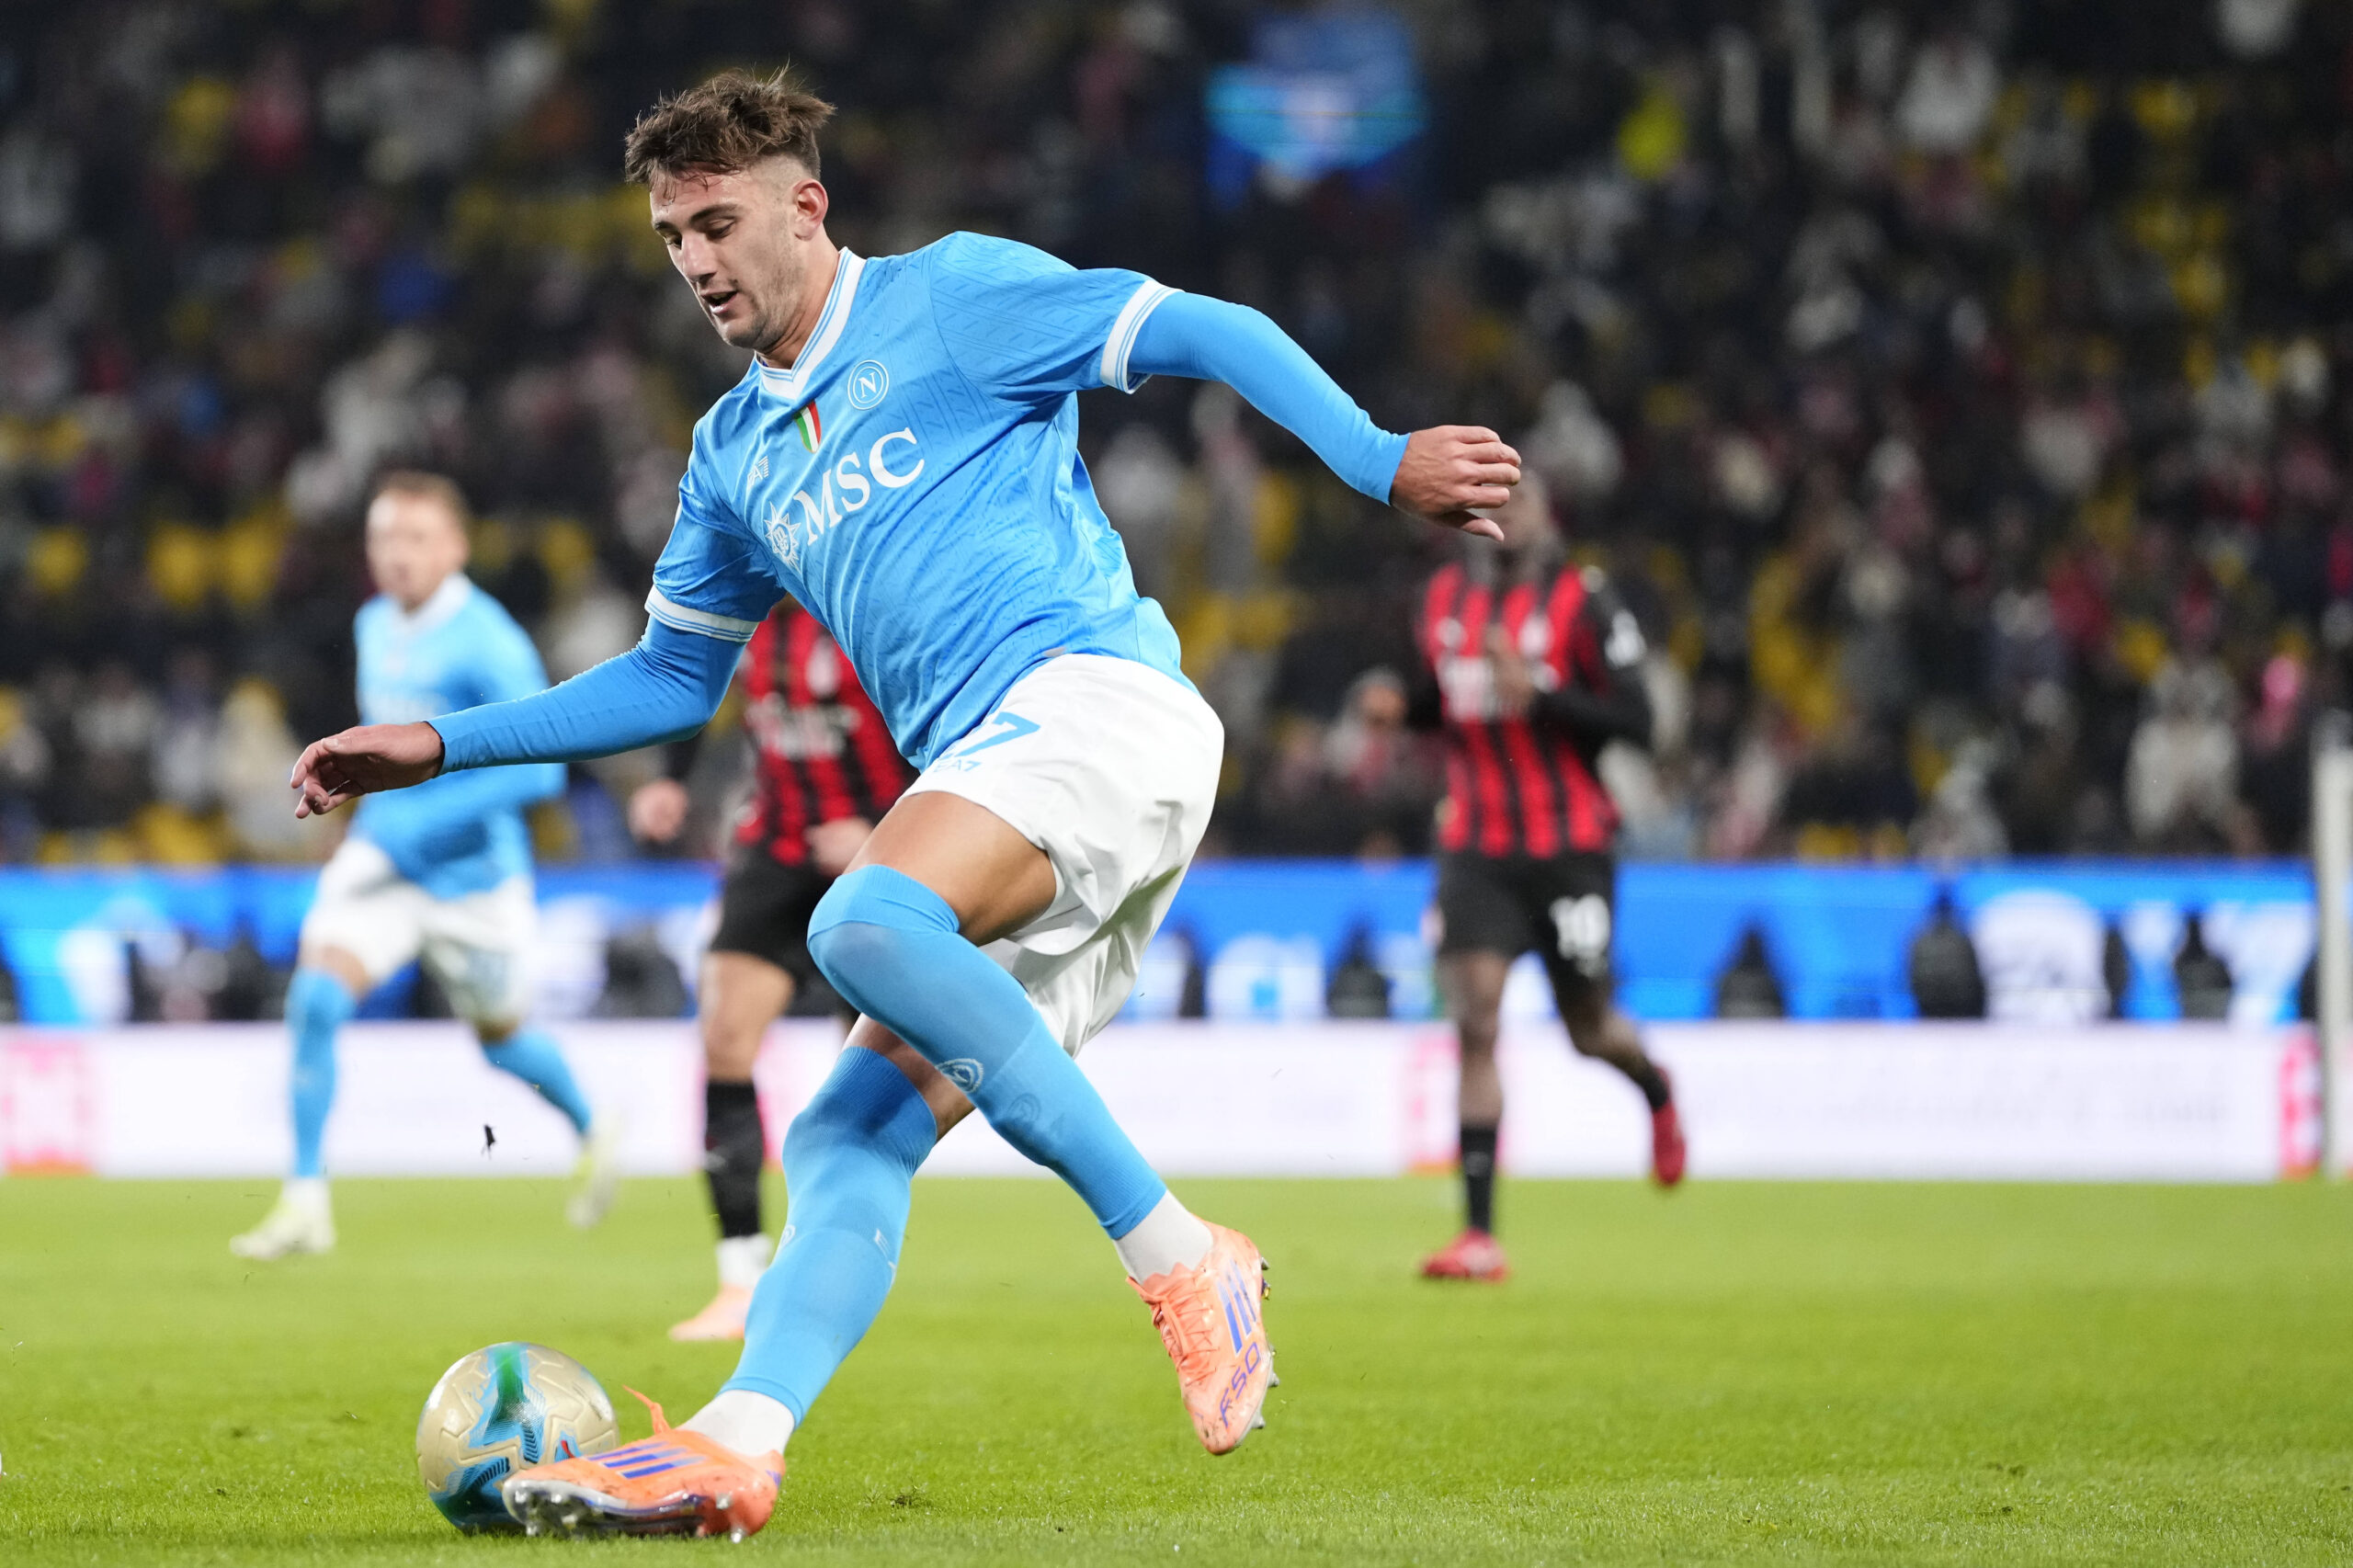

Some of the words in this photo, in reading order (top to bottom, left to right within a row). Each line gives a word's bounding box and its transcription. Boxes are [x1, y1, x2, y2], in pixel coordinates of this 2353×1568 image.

[858, 371, 877, 399] N
[793, 426, 925, 546] MSC
[938, 710, 1041, 761] 7
[1219, 1341, 1261, 1429] F50
